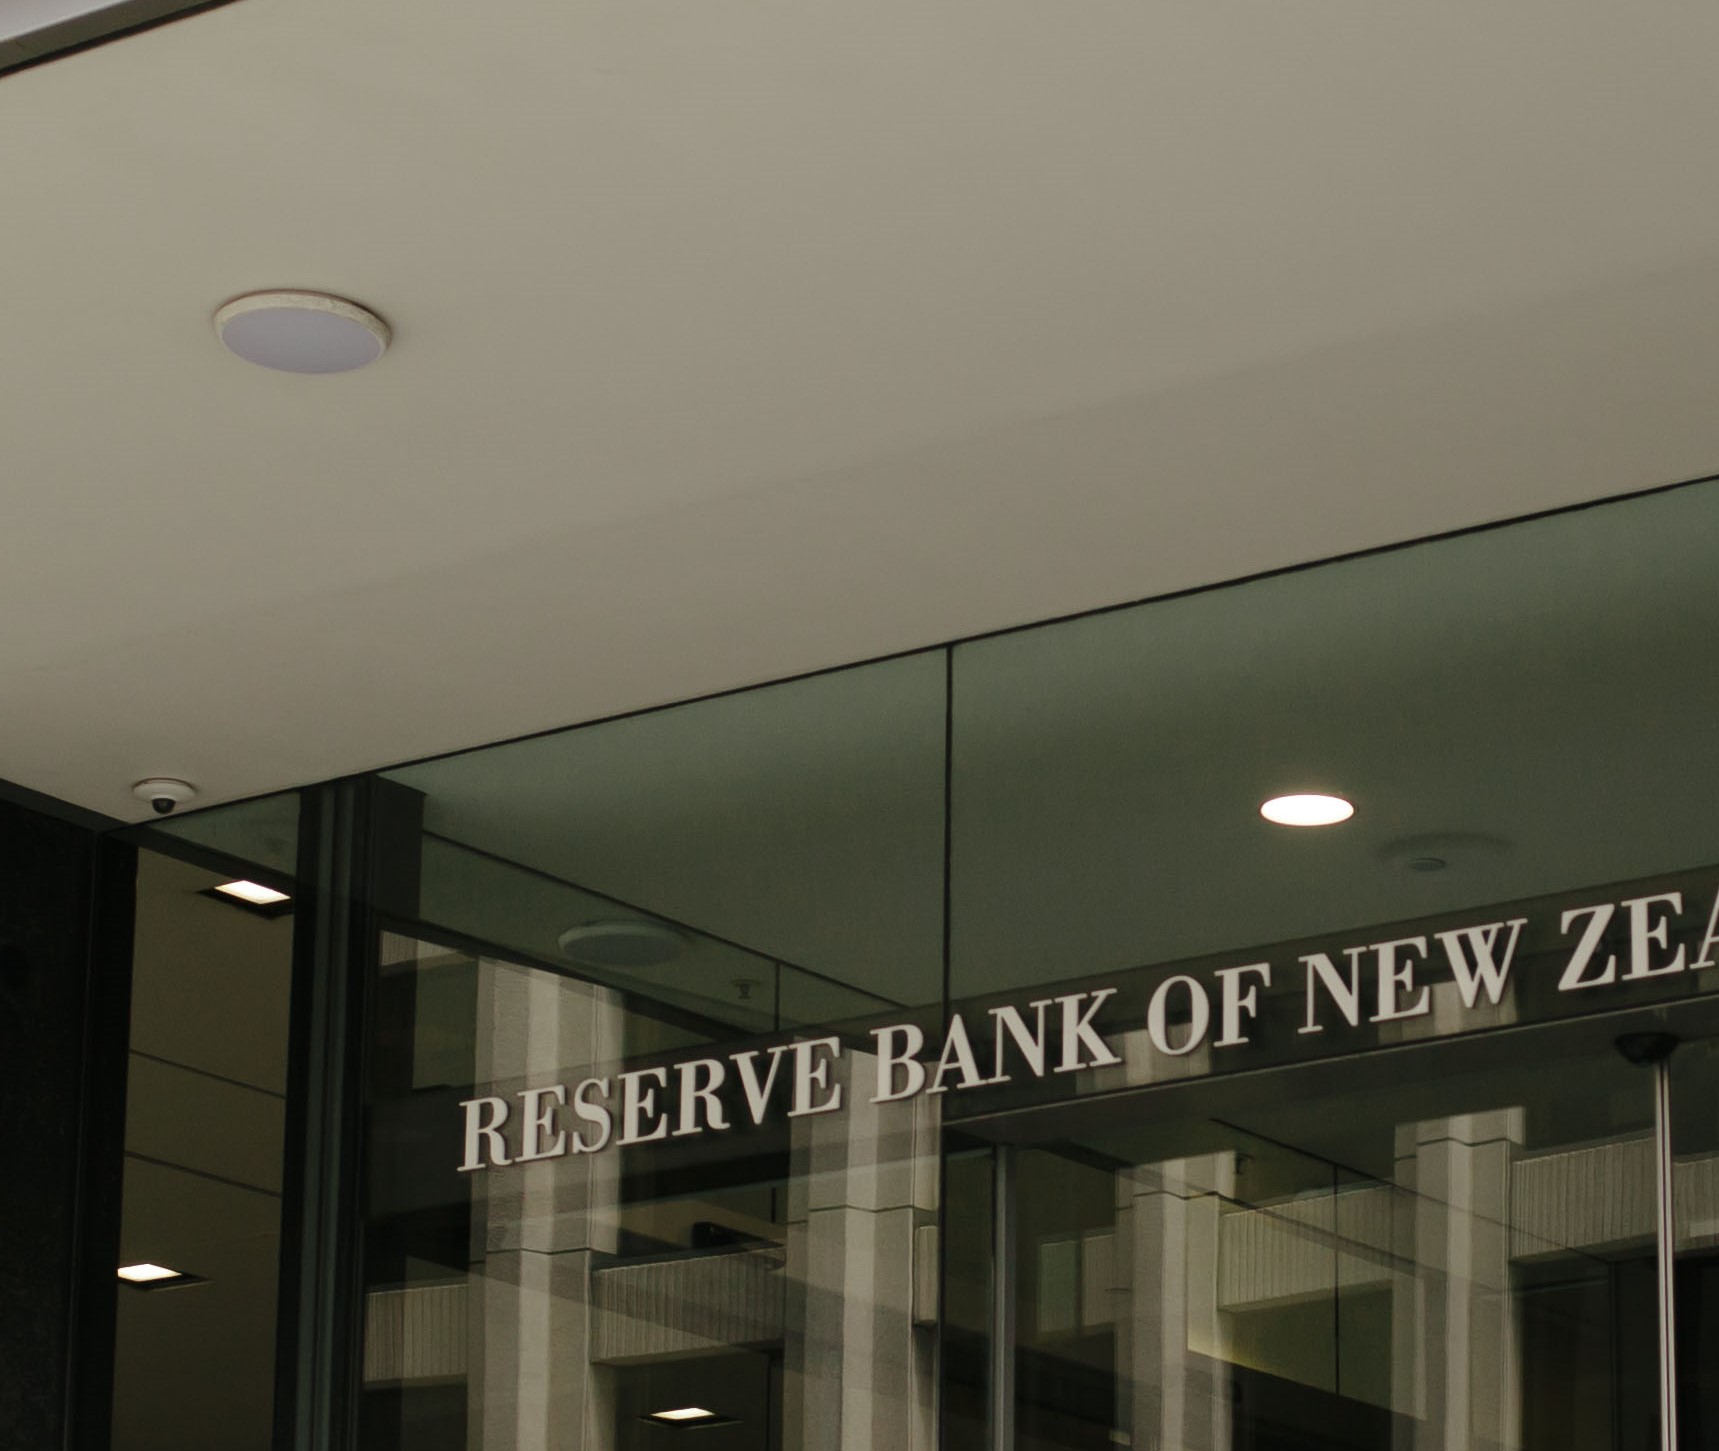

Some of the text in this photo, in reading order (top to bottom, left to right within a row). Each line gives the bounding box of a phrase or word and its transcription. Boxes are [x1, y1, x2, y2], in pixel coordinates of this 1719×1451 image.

[457, 1036, 844, 1172] RESERVE
[869, 987, 1122, 1104] BANK
[1146, 962, 1272, 1057] OF
[1297, 919, 1528, 1035] NEW
